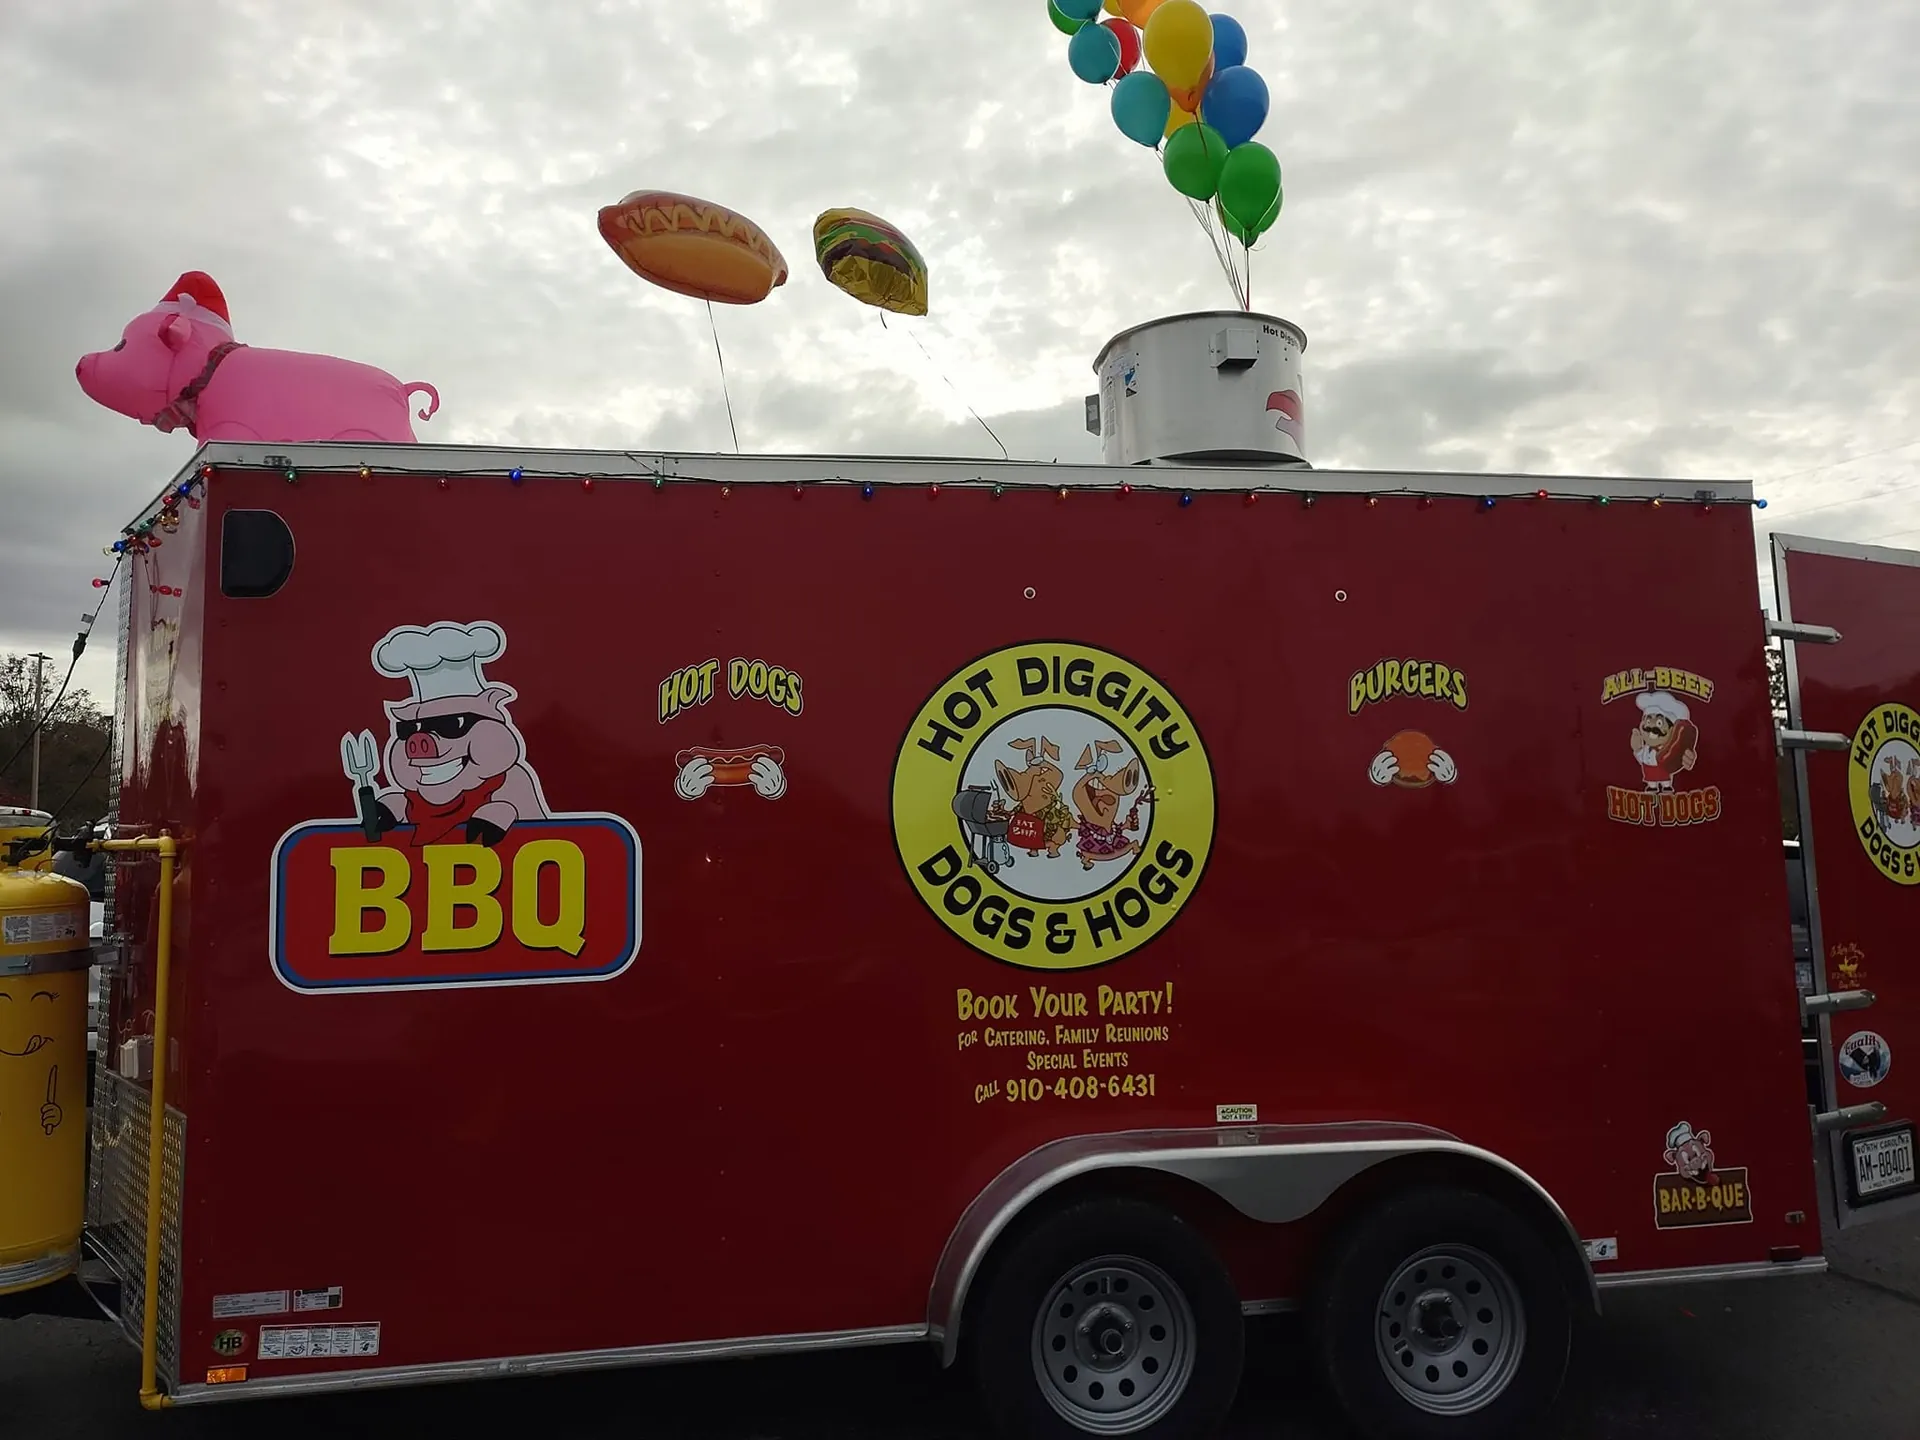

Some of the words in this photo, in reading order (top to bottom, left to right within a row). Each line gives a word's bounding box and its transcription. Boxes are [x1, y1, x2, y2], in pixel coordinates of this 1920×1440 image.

[1263, 324, 1278, 337] Hot
[659, 658, 720, 724] HOT
[728, 657, 803, 717] DOGS
[1349, 658, 1469, 716] BURGERS
[1602, 667, 1715, 705] ALL-BEEF
[917, 668, 999, 762] HOT
[1016, 655, 1190, 760] DIGGITY
[1855, 717, 1880, 769] HOT
[1607, 786, 1656, 826] HOT
[1659, 786, 1720, 827] DOGS
[1860, 816, 1900, 875] DOGS
[328, 839, 586, 957] BBQ
[917, 844, 1036, 950] DOGS
[1045, 912, 1076, 955] &
[1083, 840, 1194, 949] HOGS
[957, 988, 1019, 1021] BOOK
[1029, 986, 1088, 1018] YOUR
[1097, 982, 1173, 1016] PARTY!
[958, 1030, 978, 1050] FOR
[1055, 1025, 1099, 1045] FAMILY
[1105, 1023, 1169, 1043] REUNIONS
[1027, 1051, 1077, 1070] SPECIAL
[1083, 1048, 1129, 1068] EVENTS
[974, 1080, 1000, 1104] CALL
[1006, 1074, 1156, 1102] 910-408-6431
[1856, 1143, 1878, 1155] NORTH
[1859, 1146, 1911, 1182] AM-88401
[219, 1336, 243, 1350] HB
